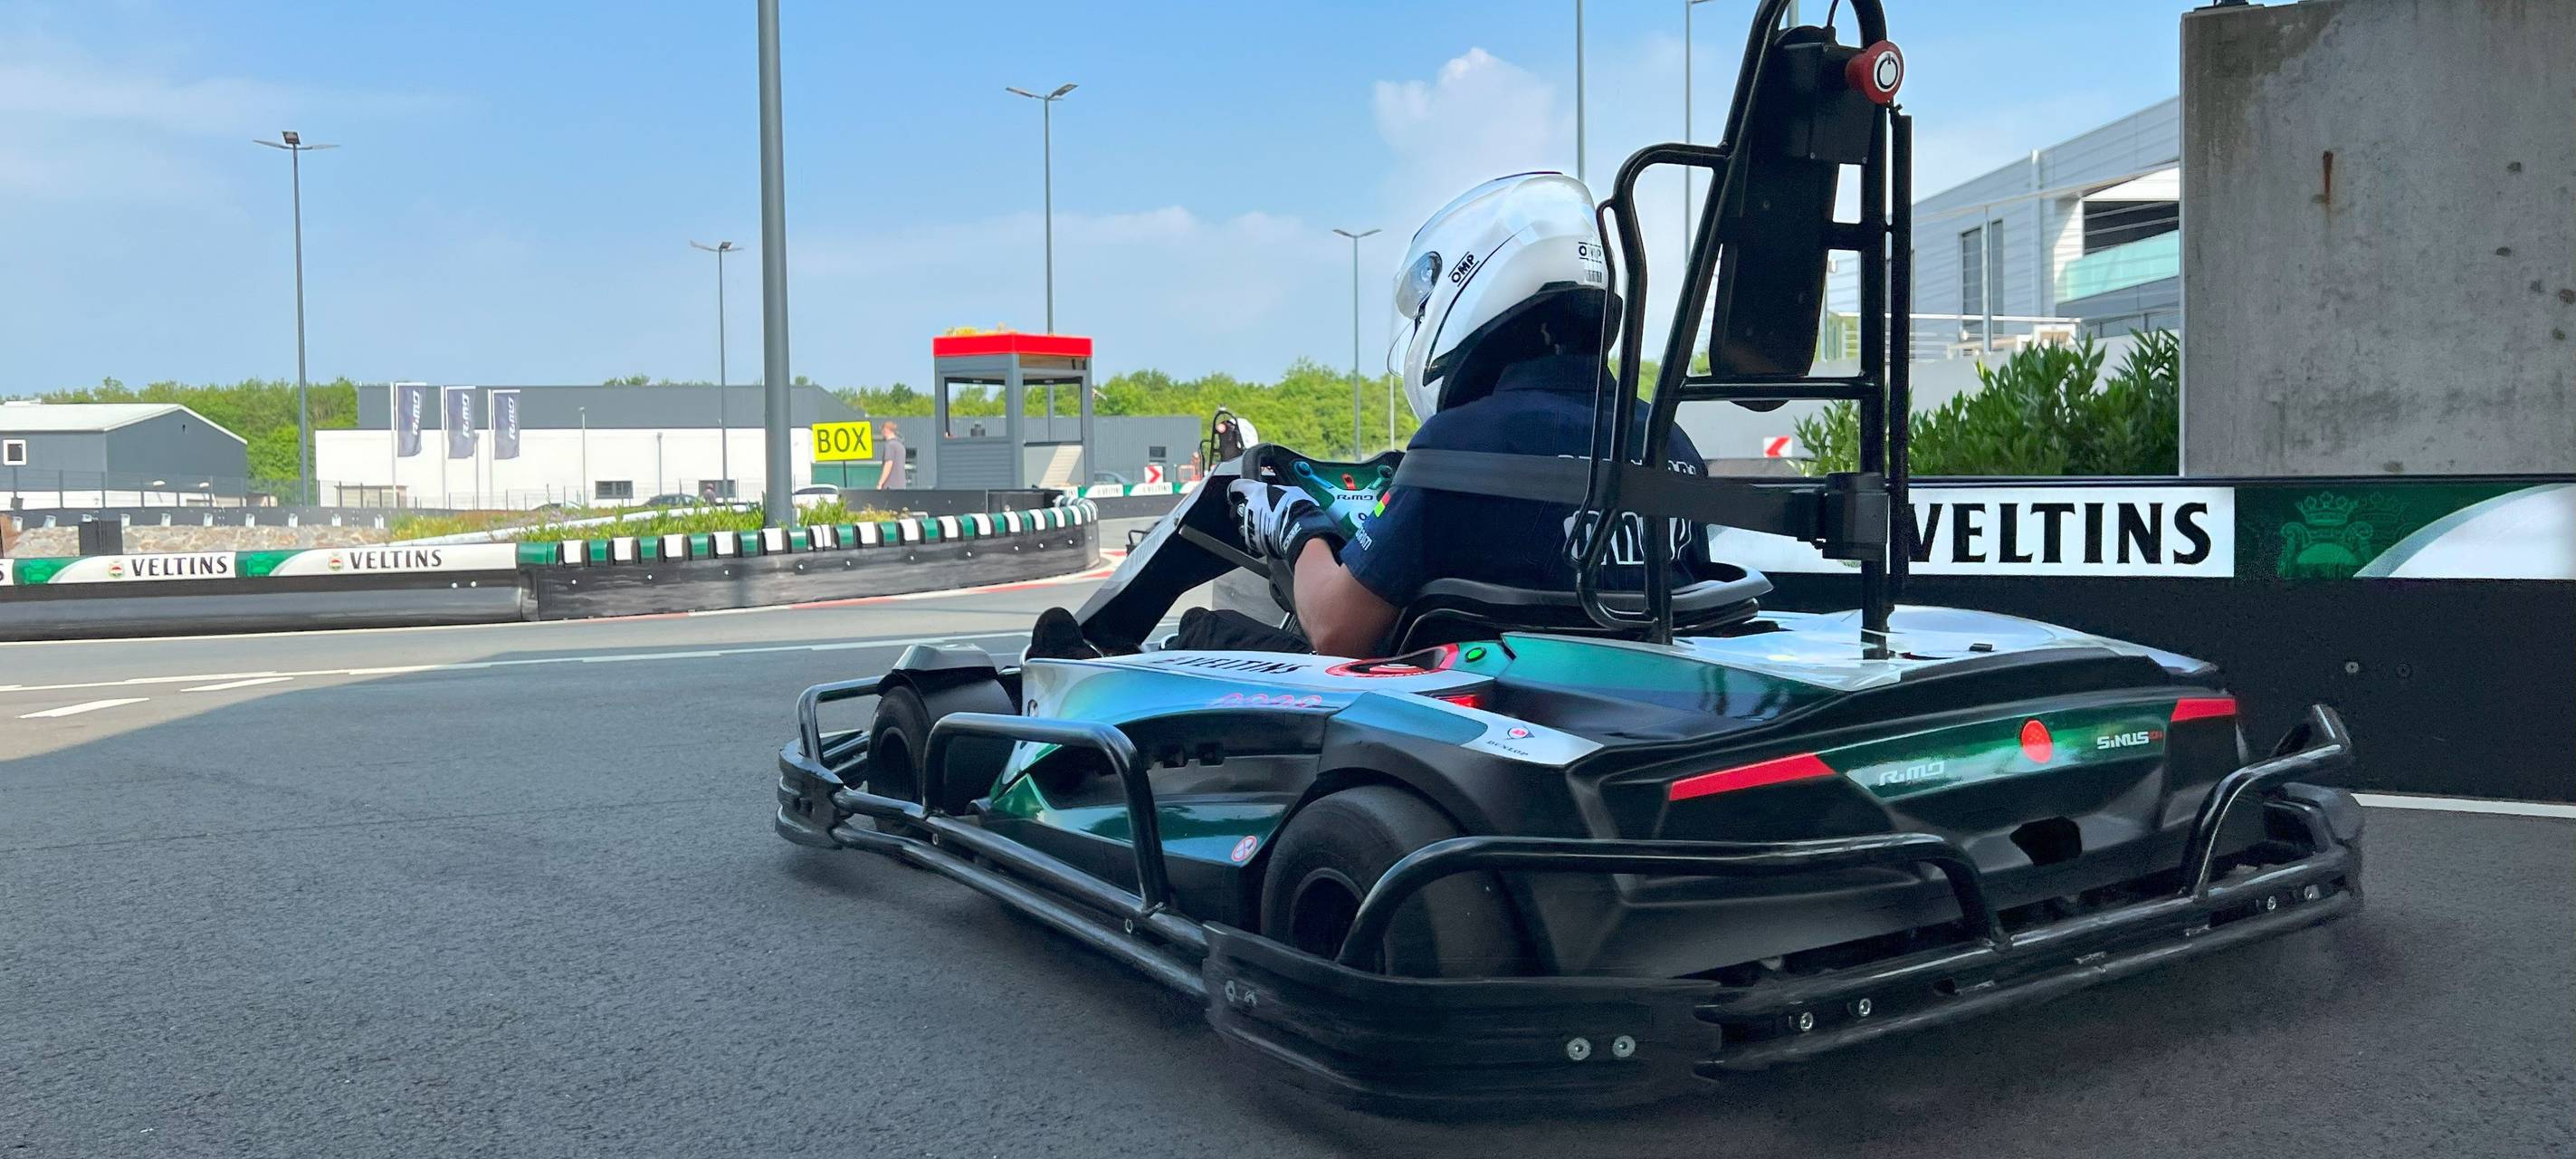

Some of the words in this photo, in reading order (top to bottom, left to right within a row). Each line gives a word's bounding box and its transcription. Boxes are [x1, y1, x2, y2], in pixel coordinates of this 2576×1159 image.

[1451, 254, 1474, 283] OMP
[817, 427, 867, 453] BOX
[1908, 502, 2211, 565] VELTINS
[131, 556, 227, 577] VELTINS
[350, 550, 443, 570] VELTINS
[1175, 657, 1312, 675] VELTINS
